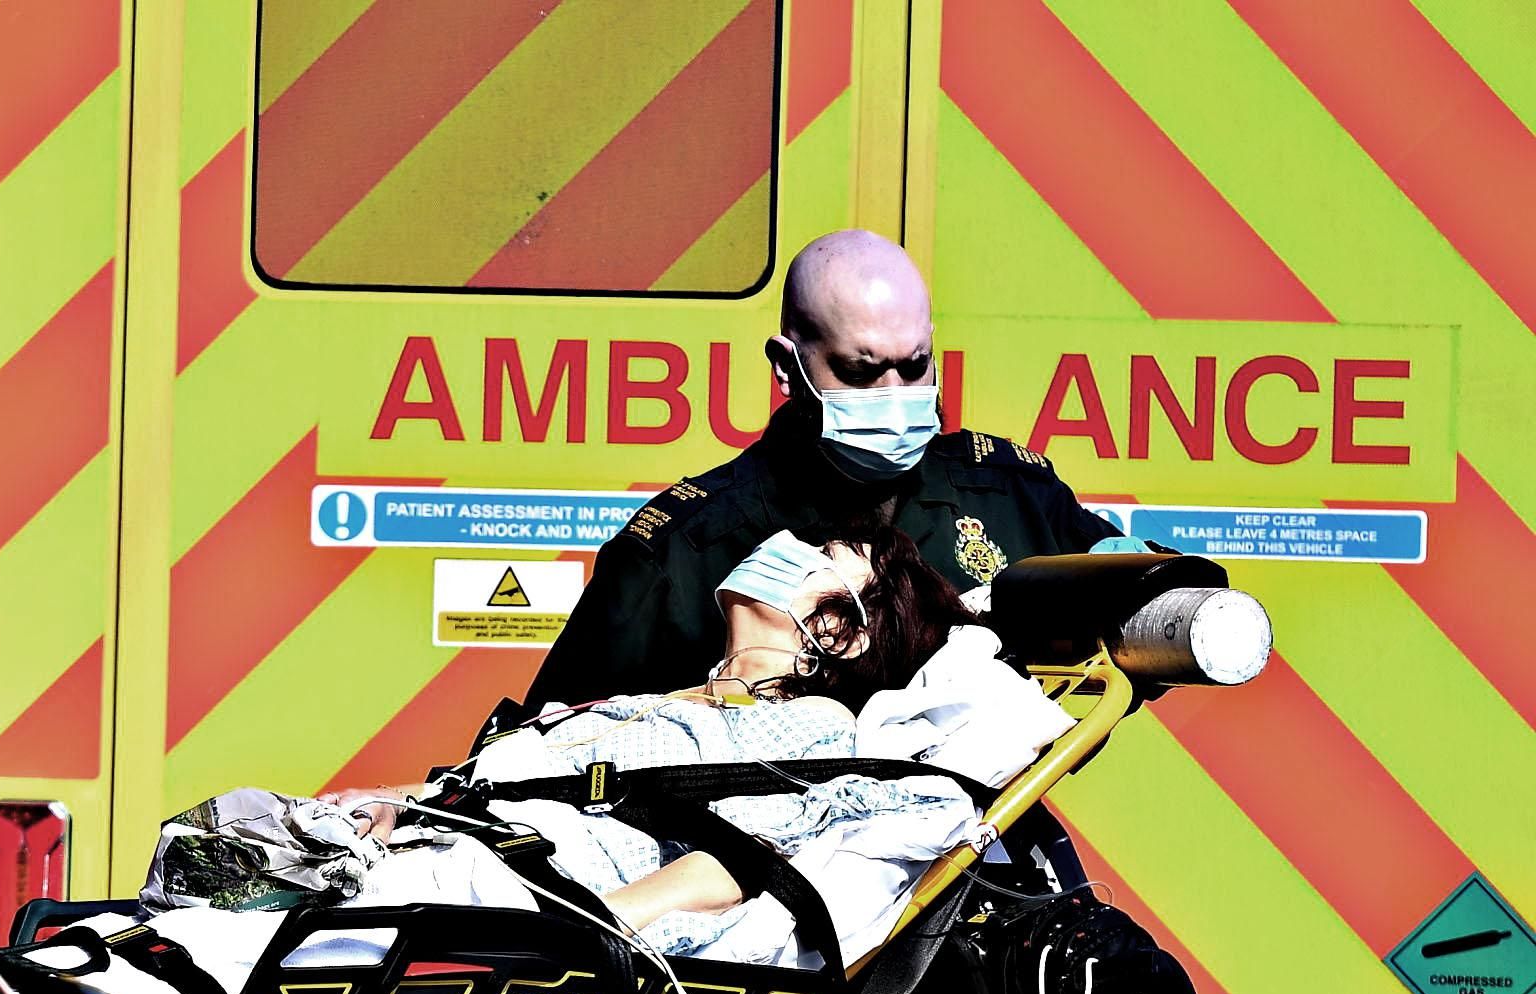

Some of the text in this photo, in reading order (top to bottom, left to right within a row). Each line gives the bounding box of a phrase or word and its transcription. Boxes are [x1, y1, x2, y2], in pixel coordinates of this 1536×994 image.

[386, 502, 633, 521] PATIENT ASSESSMENT IN PRO
[1235, 515, 1316, 527] KEEP CLEAR
[470, 523, 532, 537] KNOCK
[536, 524, 572, 538] AND
[574, 525, 618, 539] WAIT
[1172, 527, 1377, 542] PLEASE LEAVE 4 METRES SPACE
[1206, 541, 1343, 555] BEHIND THIS VEHICLE
[1429, 975, 1513, 988] COMPRESSED
